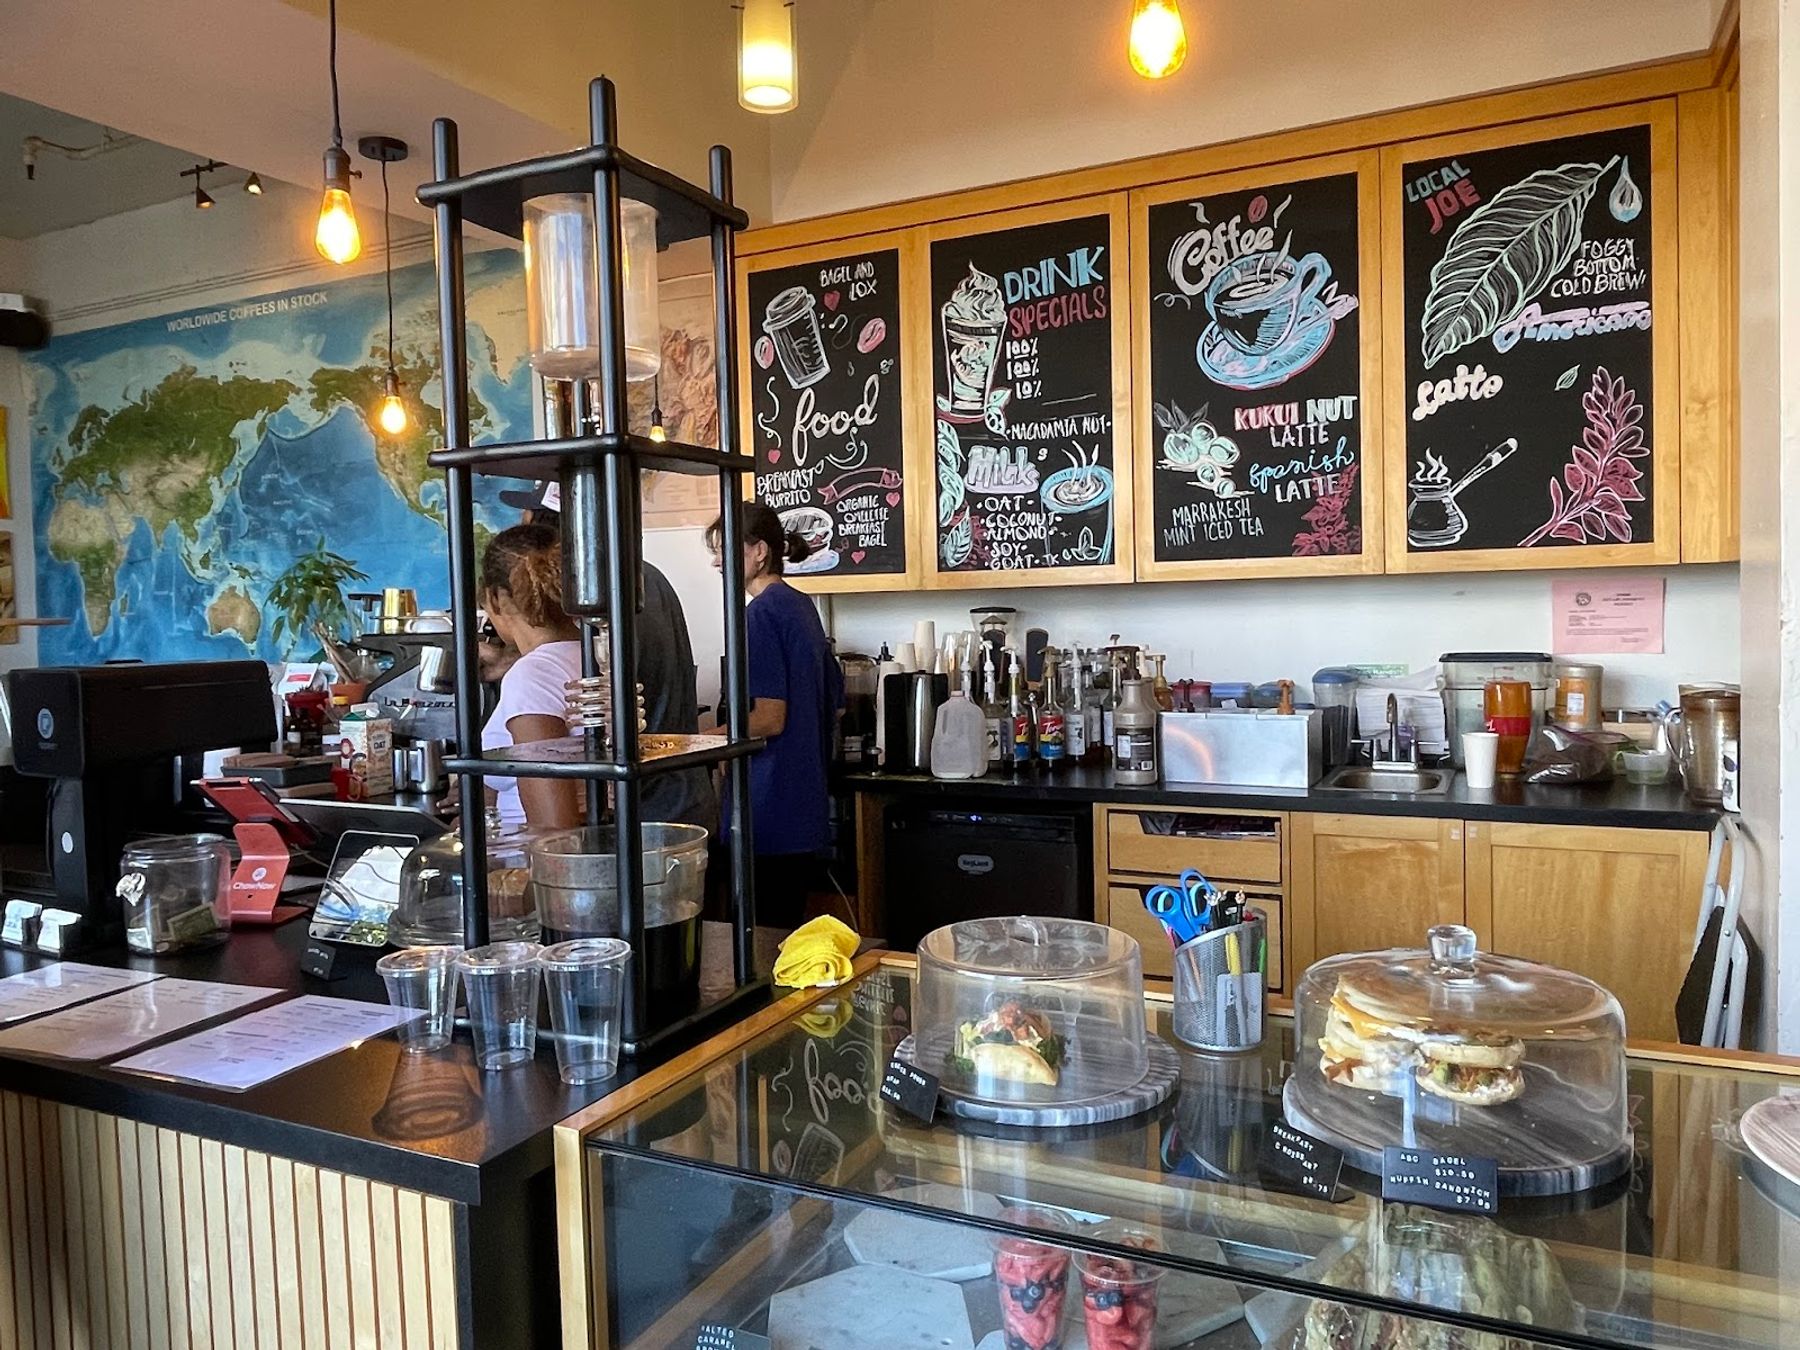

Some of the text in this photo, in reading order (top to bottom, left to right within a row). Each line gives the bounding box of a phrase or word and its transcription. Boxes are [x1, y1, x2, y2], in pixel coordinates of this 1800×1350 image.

[1406, 160, 1471, 203] LOCAL
[1424, 177, 1481, 235] JOE
[1168, 215, 1275, 296] Coffee
[1580, 238, 1635, 260] FOGGY
[820, 260, 875, 288] BAGEL AND
[1003, 246, 1105, 305] DRINK
[1550, 276, 1592, 299] COLD
[848, 278, 878, 302] LOX
[166, 291, 329, 332] WORLDWIDE COFFEES IN STOCK
[1009, 285, 1108, 339] SPECIALS
[791, 373, 879, 466] food
[1233, 395, 1358, 432] KUKUI NUT
[1010, 414, 1107, 441] MACADAMIA NUT
[1269, 421, 1331, 448] LATTE
[756, 467, 817, 496] BREAKFAST
[1274, 473, 1342, 503] LATTE
[764, 488, 812, 509] BURRITO
[835, 494, 880, 513] ORGANIC
[984, 495, 1025, 512] OAT
[1171, 497, 1251, 527] MARRAKESH
[837, 520, 884, 537] BREAKFAST
[985, 511, 1056, 529] COCONUT
[986, 525, 1047, 541] ALMOND
[1163, 516, 1264, 548] MINT ICED TEA
[858, 534, 888, 548] BAGEL
[990, 541, 1022, 558] SOY
[990, 553, 1035, 571] GOAT
[1273, 1125, 1314, 1152] BREAKFAST
[1432, 1156, 1467, 1167] BAGEL
